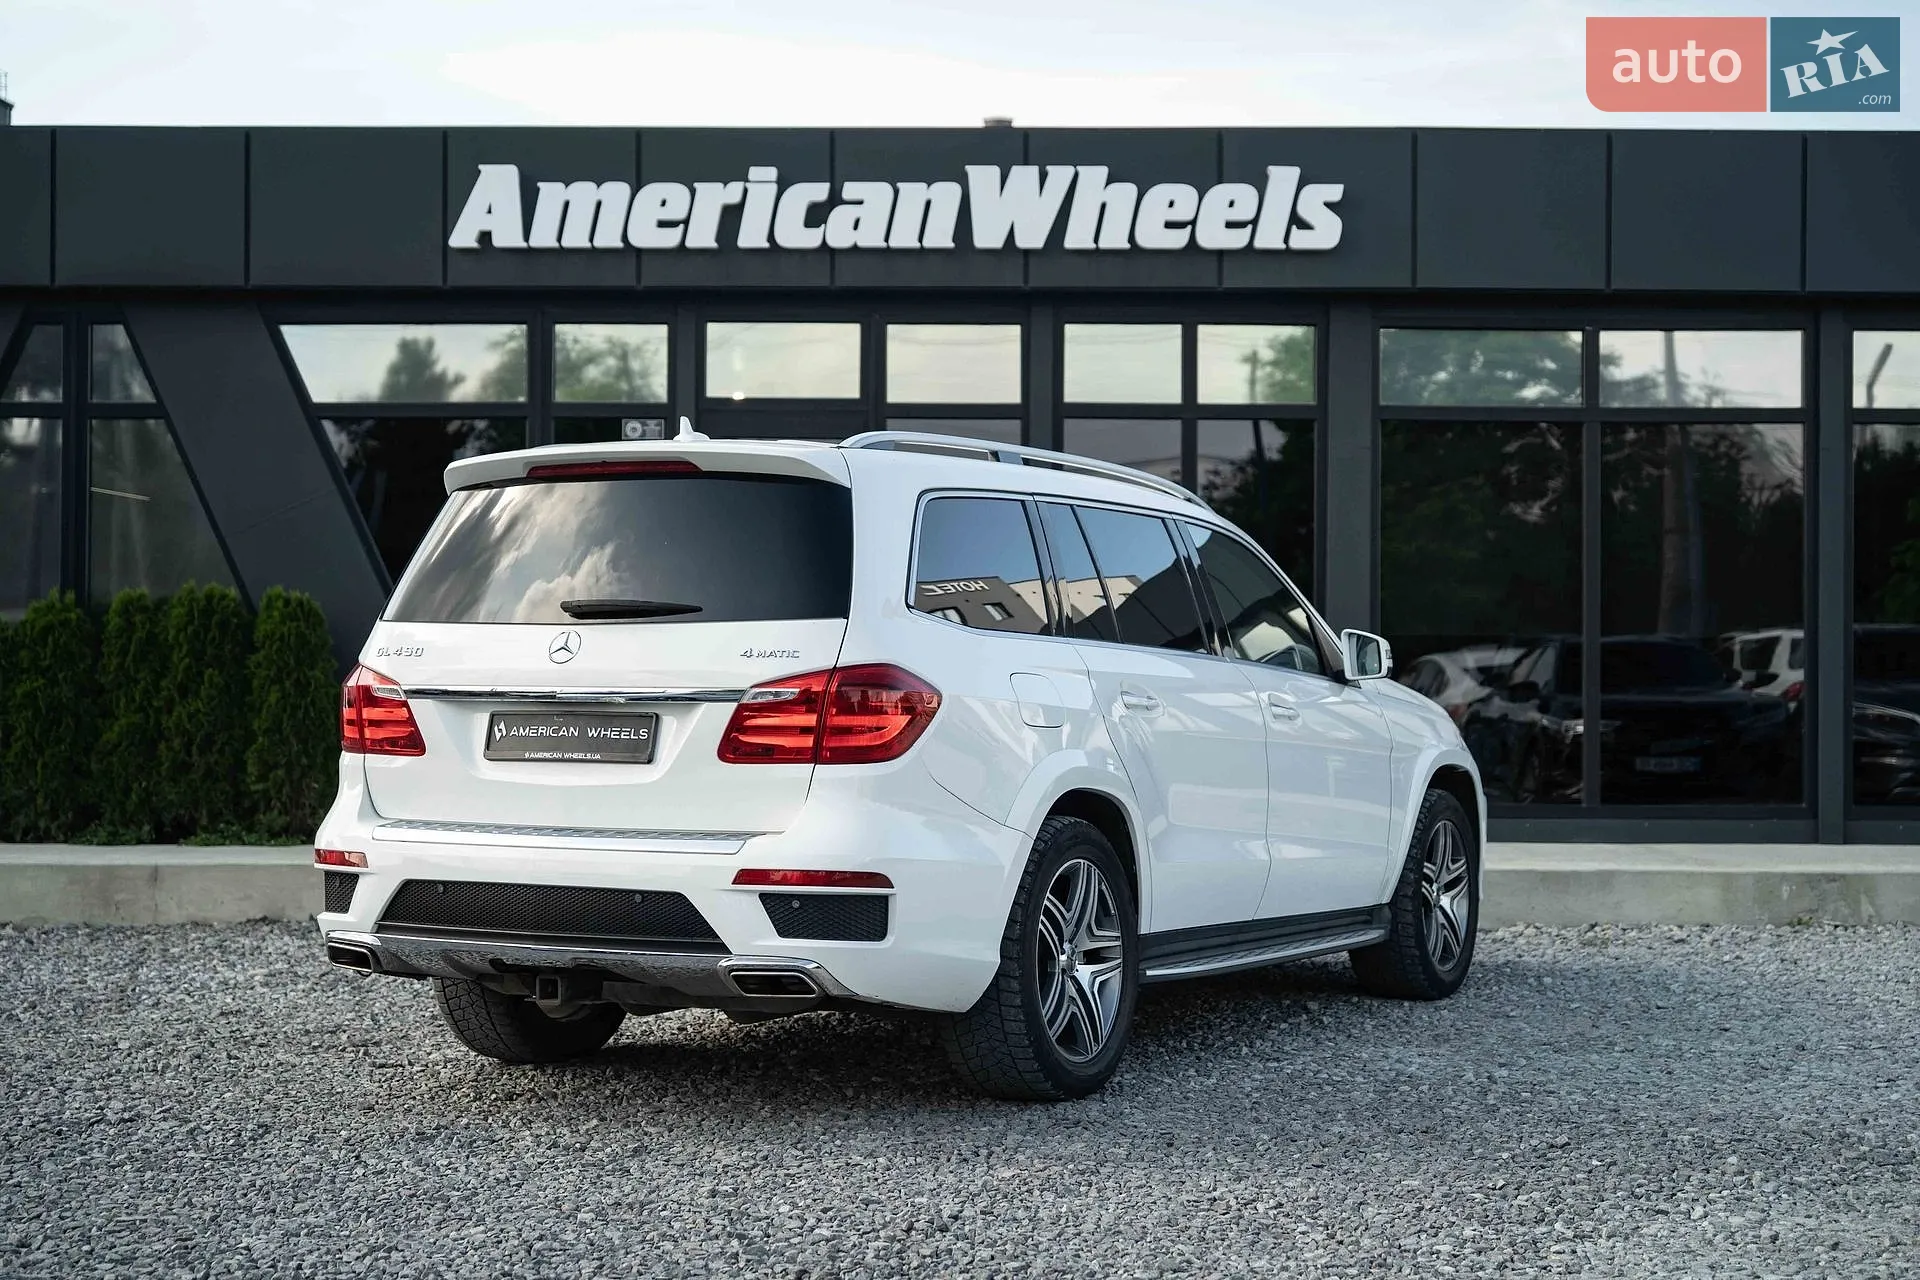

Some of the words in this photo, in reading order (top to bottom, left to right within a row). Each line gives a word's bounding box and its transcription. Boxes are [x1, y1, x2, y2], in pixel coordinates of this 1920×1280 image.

[448, 164, 1344, 250] AmericanWheels
[509, 726, 579, 737] AMERICAN
[587, 727, 649, 740] WHEELS
